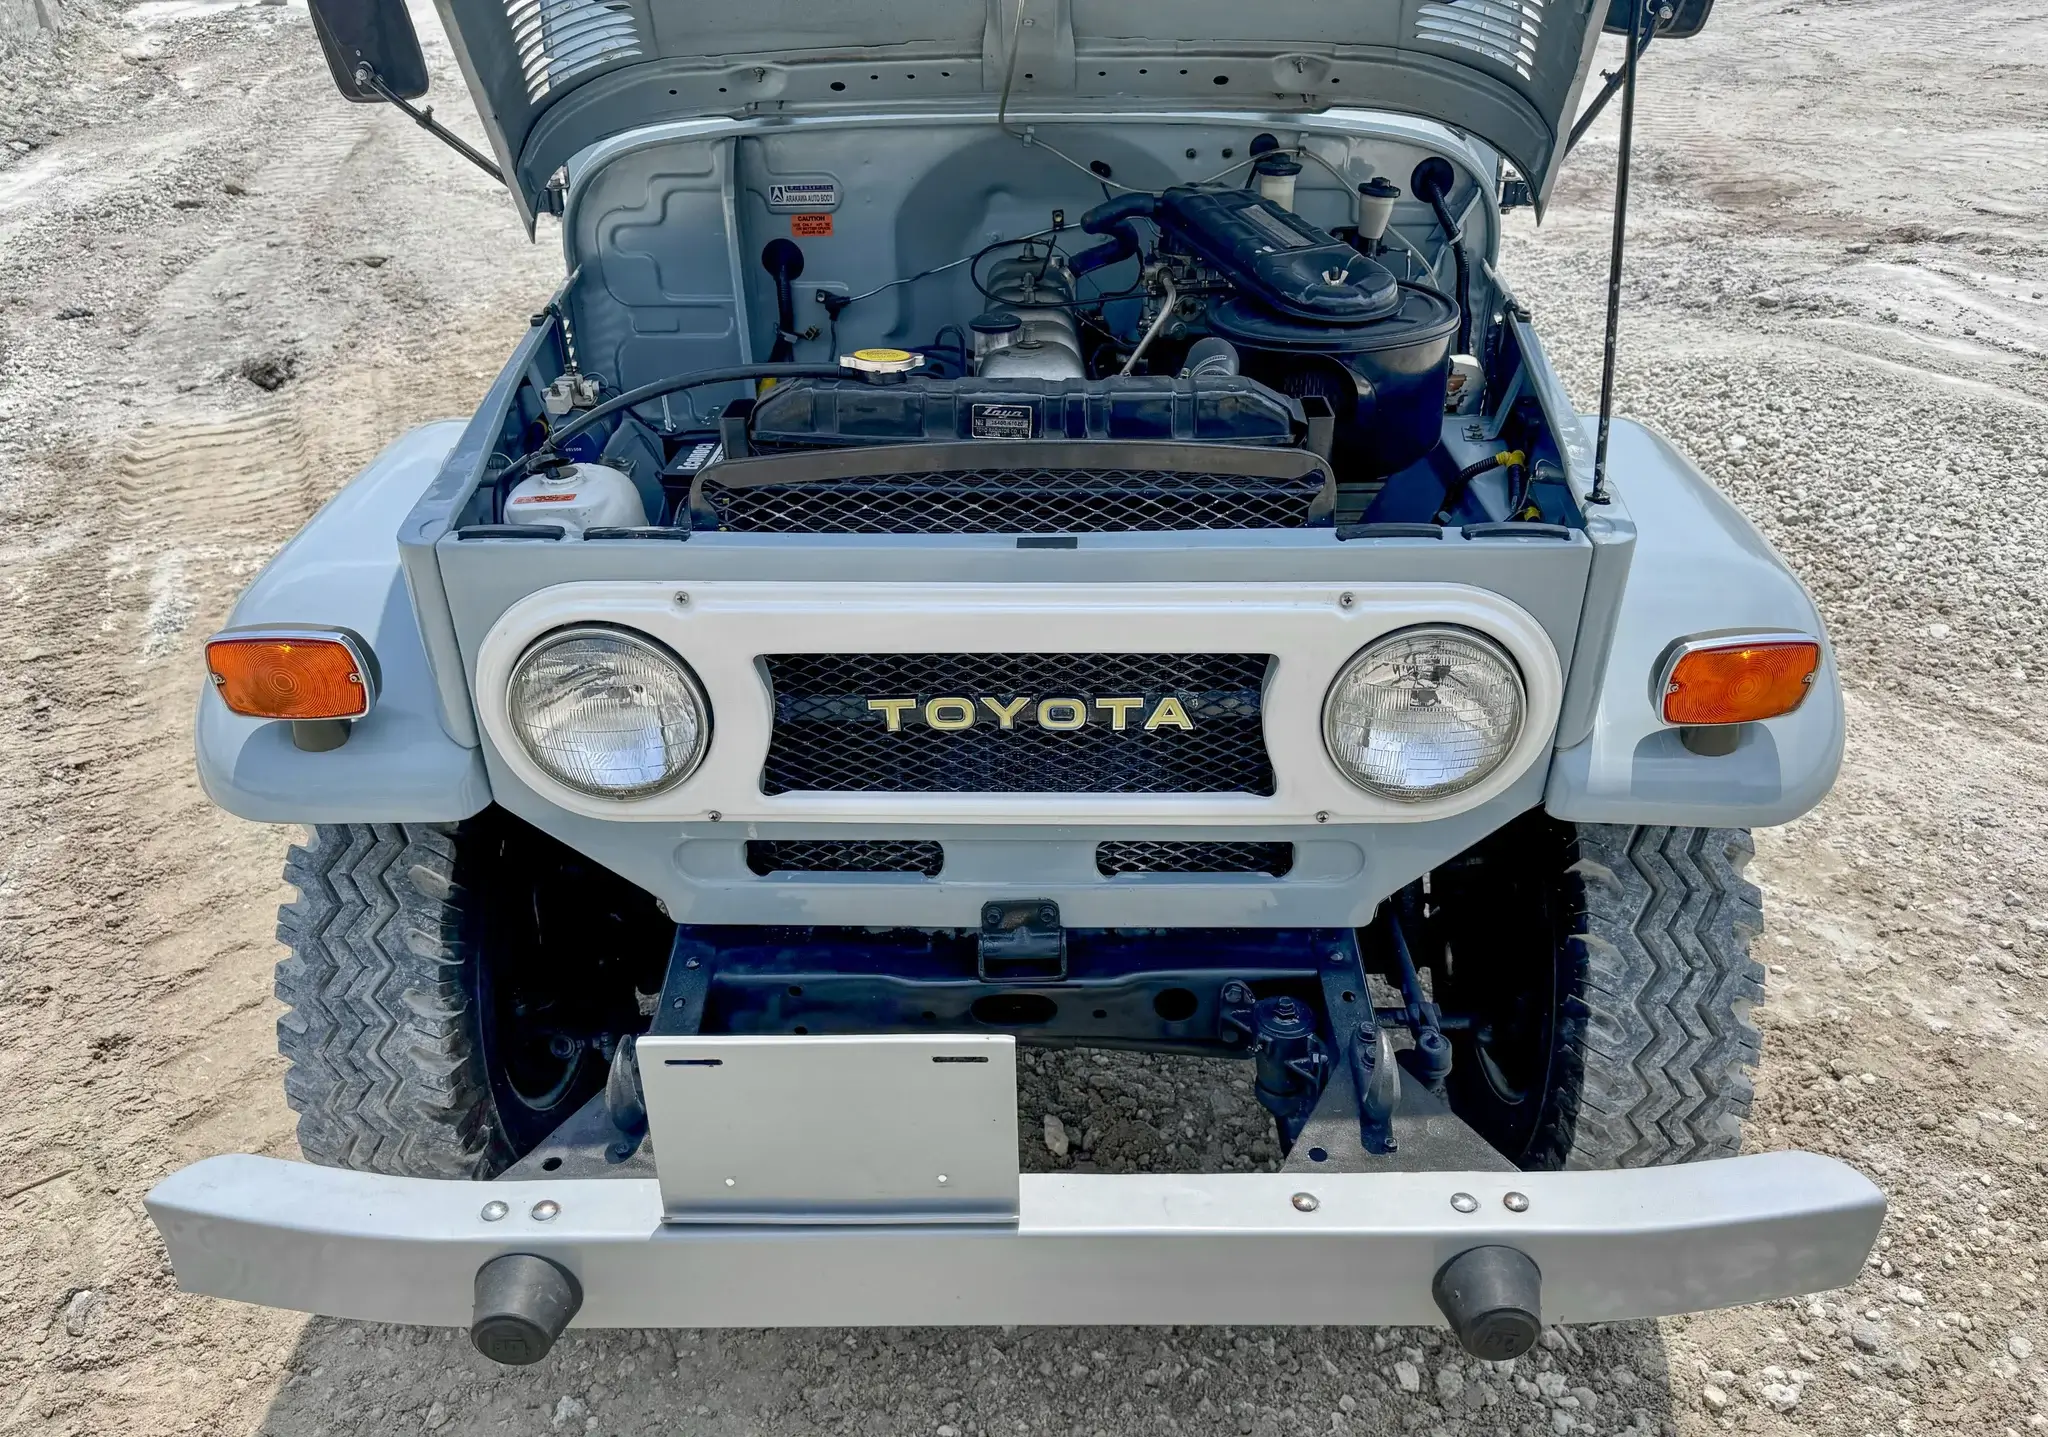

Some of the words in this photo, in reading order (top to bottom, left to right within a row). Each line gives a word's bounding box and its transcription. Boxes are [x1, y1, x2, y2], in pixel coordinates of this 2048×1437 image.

[808, 194, 820, 202] AUTO
[820, 194, 833, 202] BODY
[867, 697, 1194, 732] TOYOTA
